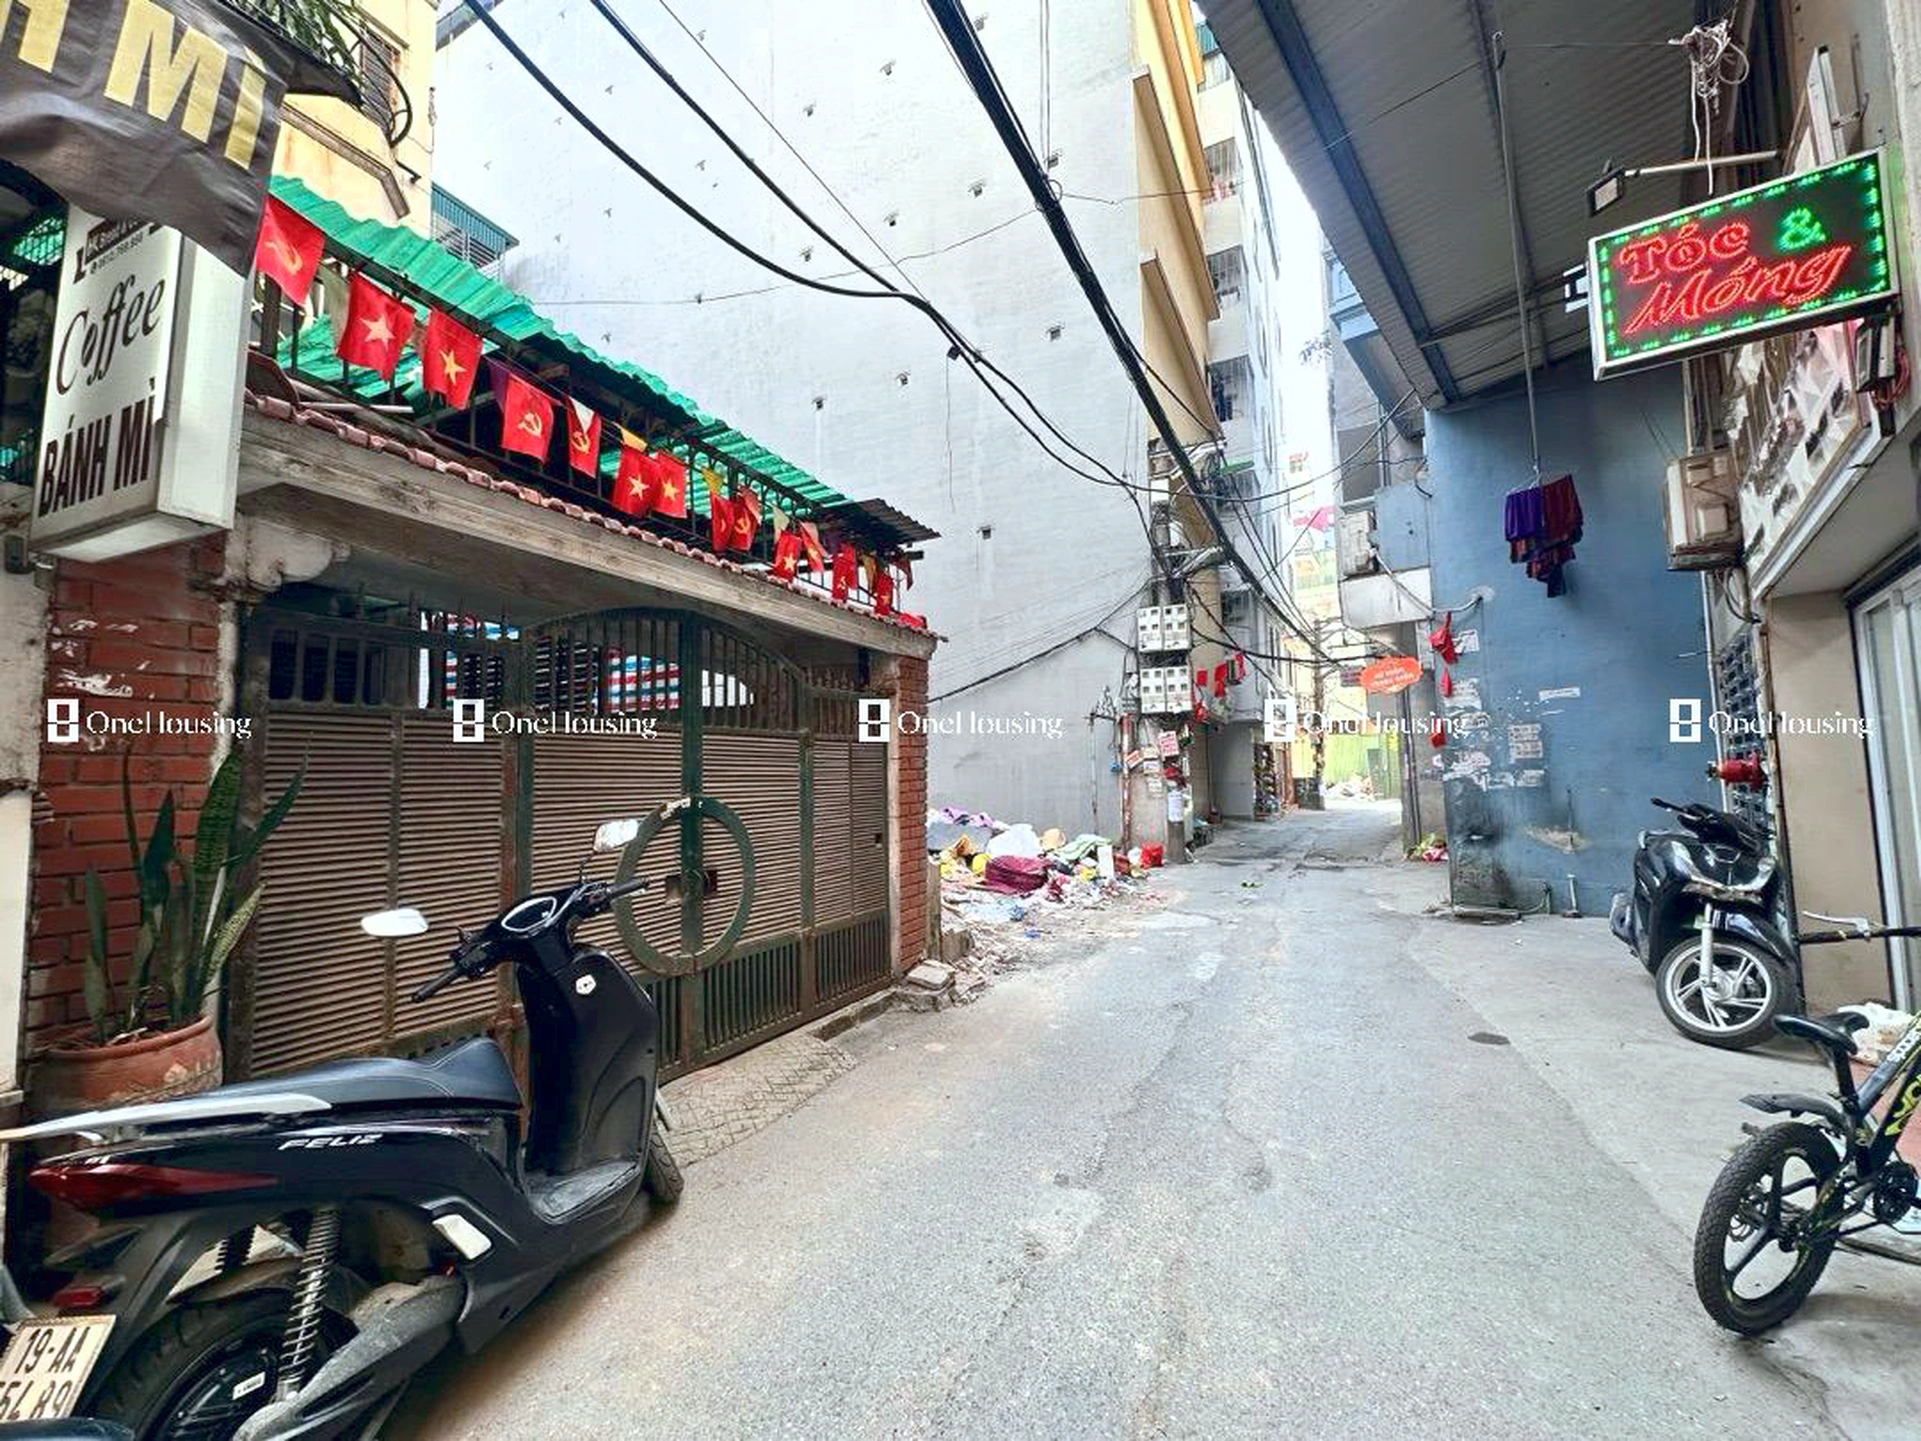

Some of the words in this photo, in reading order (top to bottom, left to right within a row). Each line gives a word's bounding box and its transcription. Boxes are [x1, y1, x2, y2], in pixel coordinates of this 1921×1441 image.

[1619, 221, 1751, 285] Tóc
[1777, 206, 1829, 252] &
[1622, 245, 1853, 336] Móng
[56, 273, 166, 396] Coffee
[37, 413, 113, 518] BÁNH
[112, 376, 157, 492] MÌ
[277, 1133, 384, 1151] FELIZ
